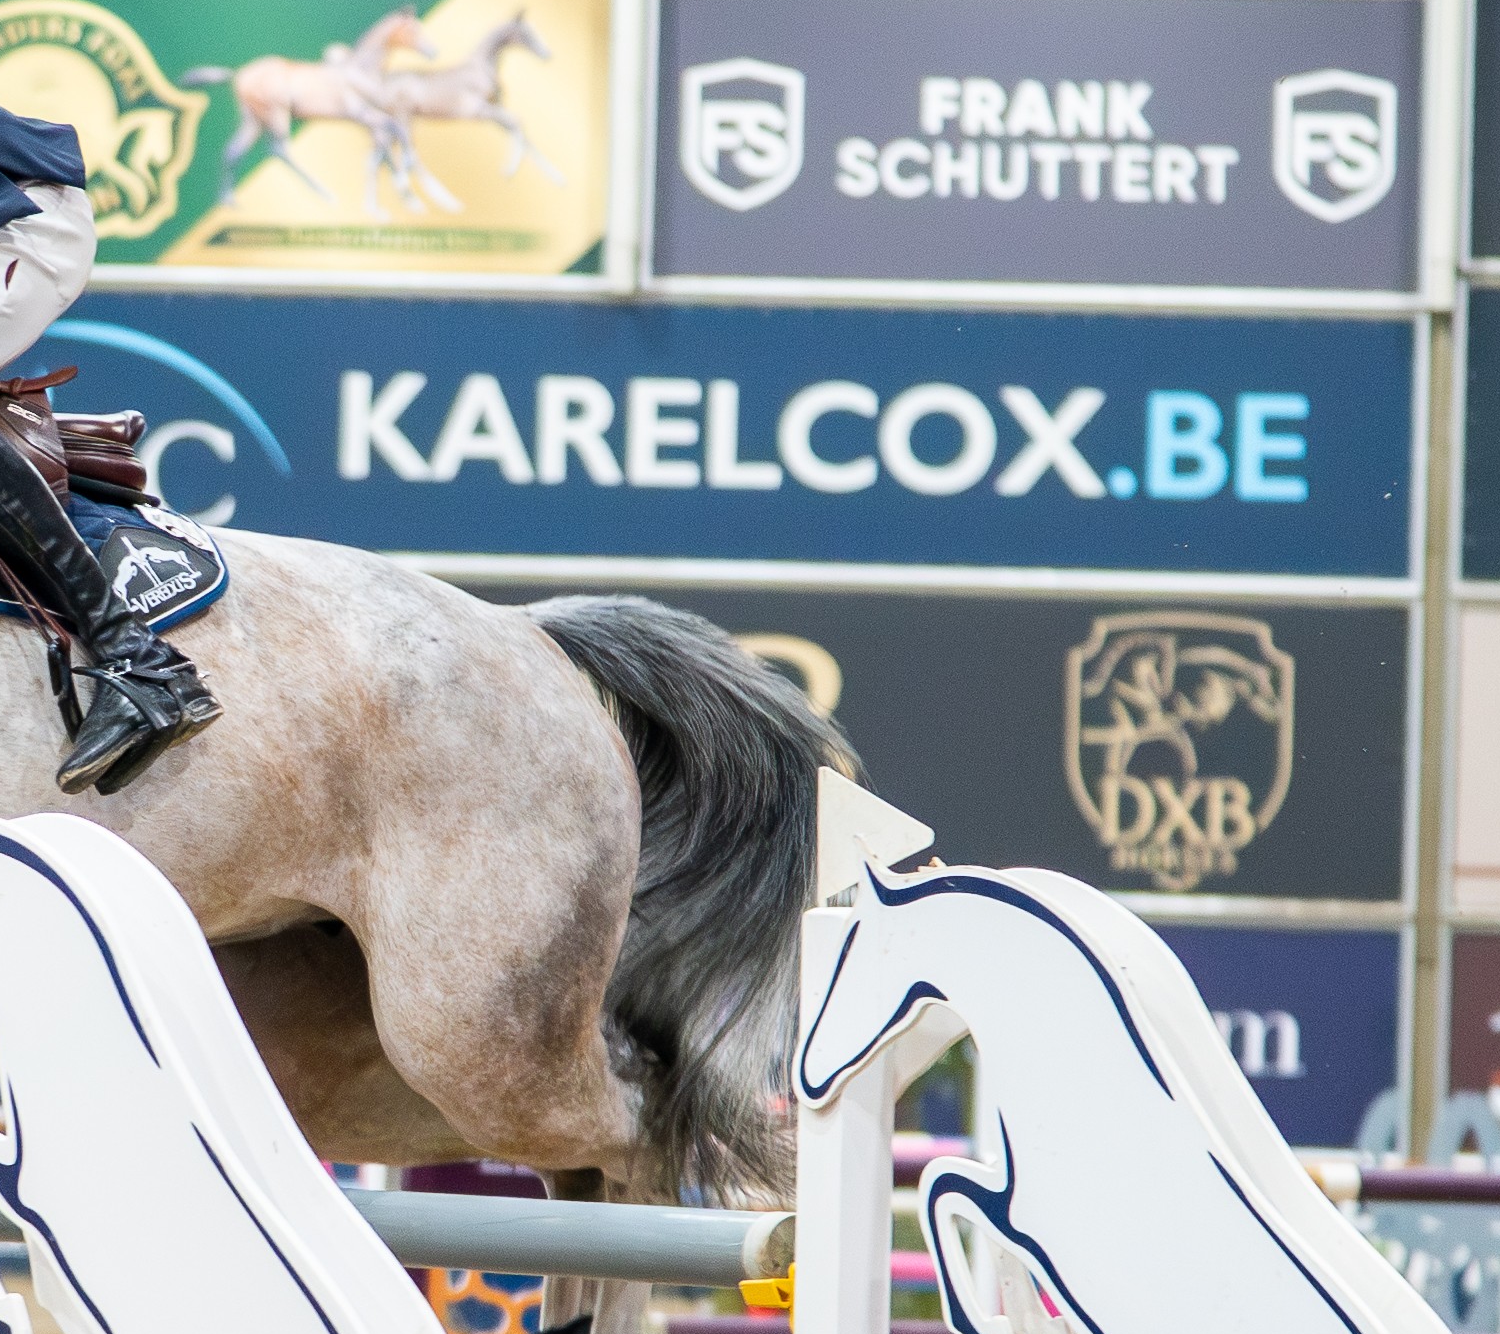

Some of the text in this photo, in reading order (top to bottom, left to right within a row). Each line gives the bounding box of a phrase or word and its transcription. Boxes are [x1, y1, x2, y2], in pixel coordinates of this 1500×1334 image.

[919, 76, 1156, 141] FRANK
[833, 138, 1242, 205] SCHUTTERT
[337, 367, 1310, 503] KARELCOX.BE
[130, 572, 198, 614] VEREDUS
[1099, 774, 1257, 848] DXB
